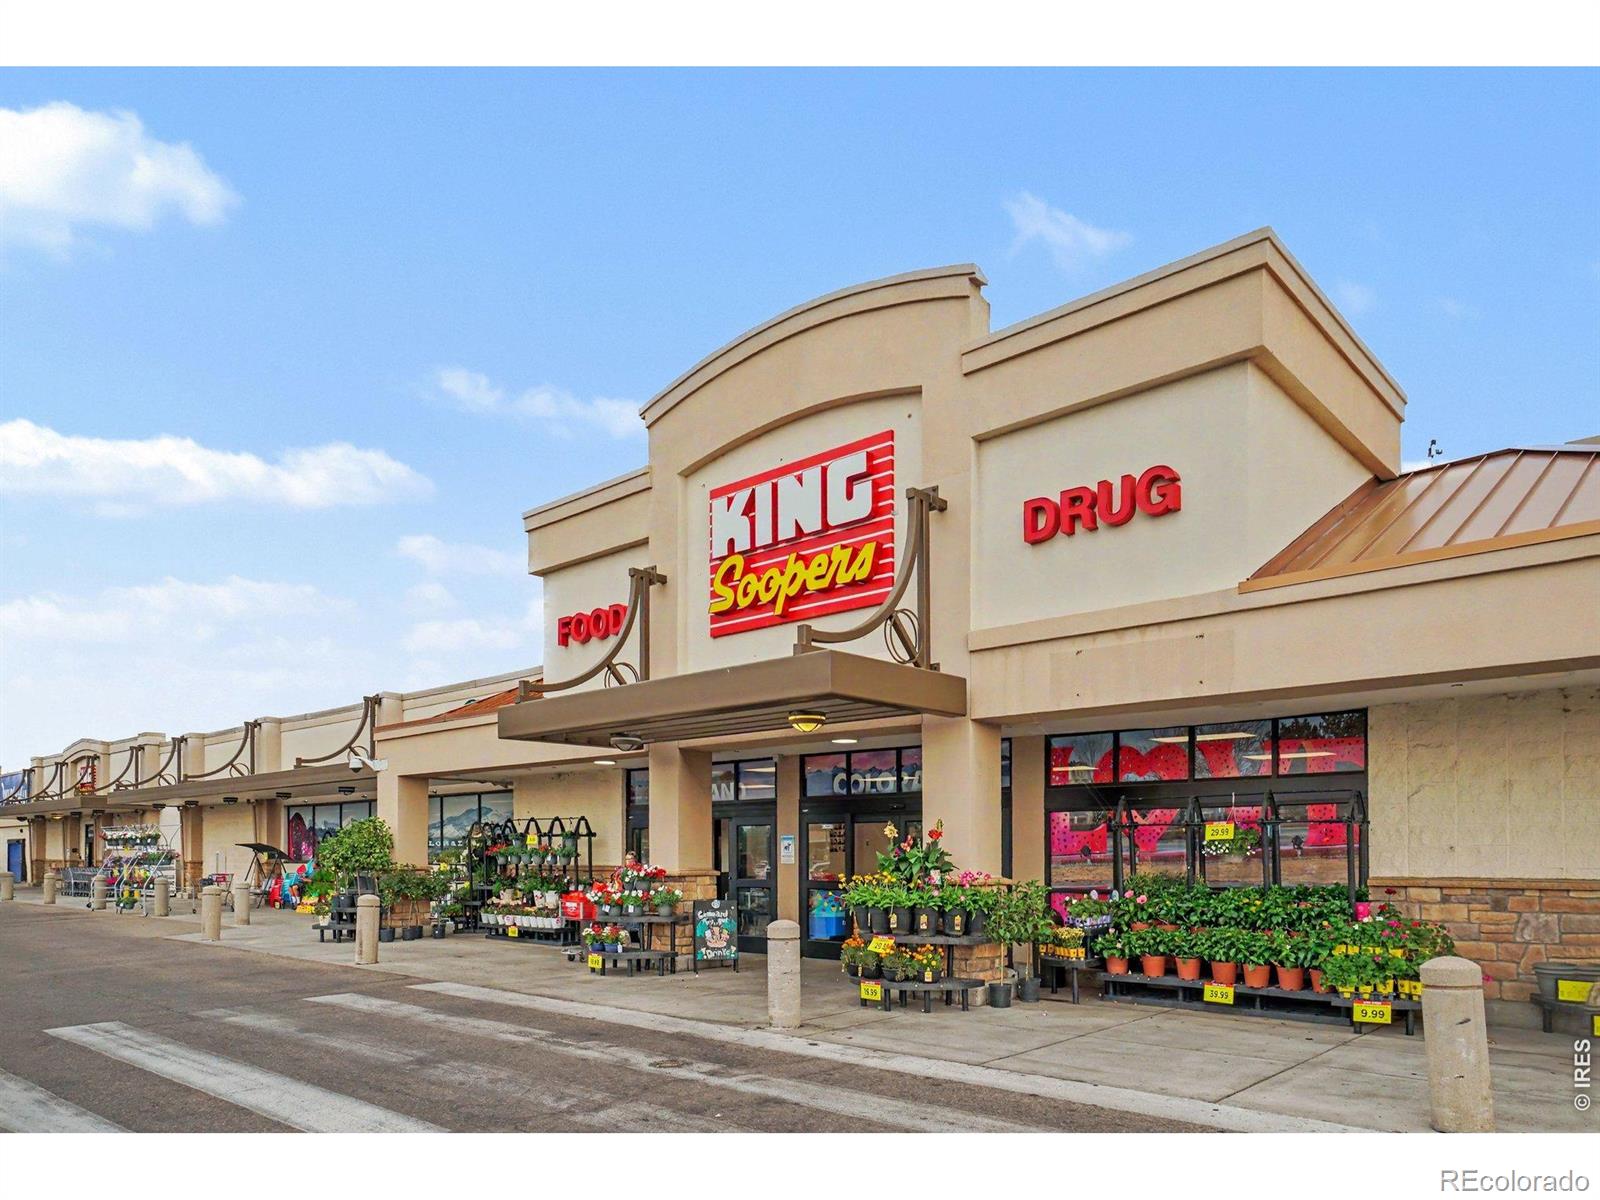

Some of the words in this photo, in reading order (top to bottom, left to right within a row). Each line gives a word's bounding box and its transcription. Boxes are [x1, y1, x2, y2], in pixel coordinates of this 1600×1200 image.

[711, 450, 873, 559] KING
[1024, 465, 1181, 545] DRUG
[708, 541, 877, 616] Soopers
[558, 603, 629, 647] FOOD
[1210, 828, 1229, 837] 29.99
[1210, 990, 1229, 999] 39.99
[1361, 1009, 1385, 1019] 9.99
